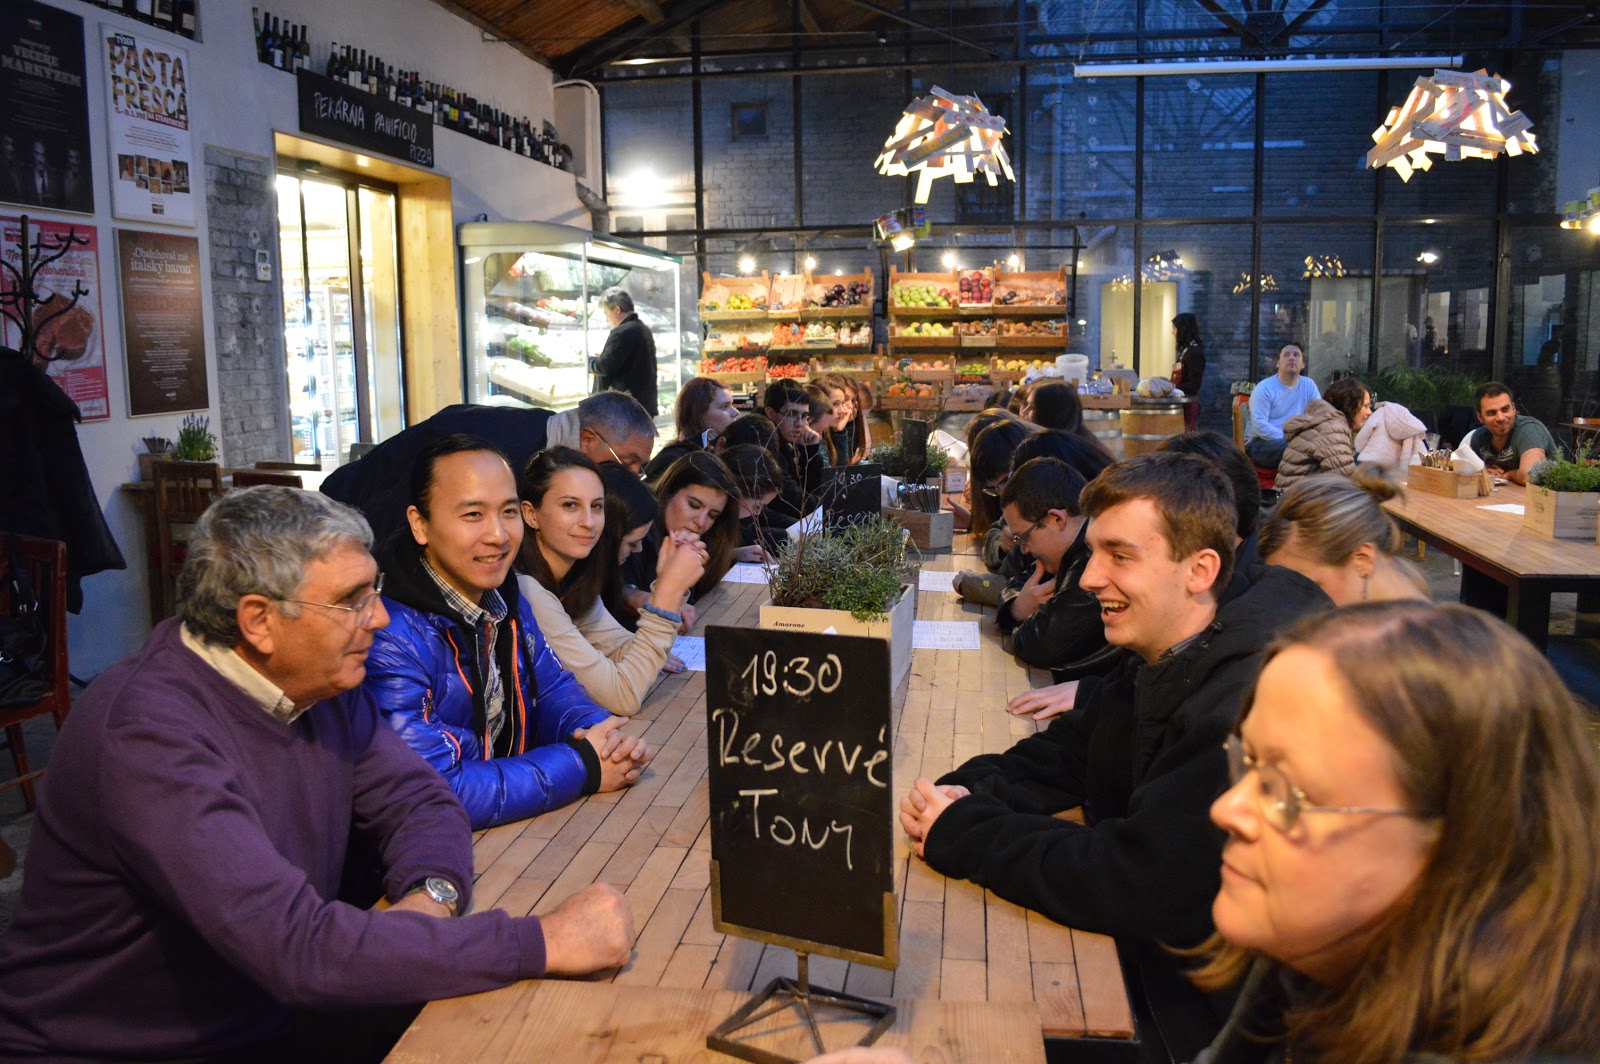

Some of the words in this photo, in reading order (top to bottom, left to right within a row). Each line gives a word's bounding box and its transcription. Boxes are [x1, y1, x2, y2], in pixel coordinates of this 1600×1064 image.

[107, 37, 187, 94] PASTA
[111, 75, 189, 121] FRESCA
[313, 91, 365, 129] PEKÁRNA
[374, 112, 418, 143] PANIFICIO
[409, 144, 433, 165] PIZZA
[131, 257, 164, 275] italský
[773, 620, 806, 629] Amarone
[741, 650, 843, 698] 19:30
[712, 707, 889, 788] Reservé
